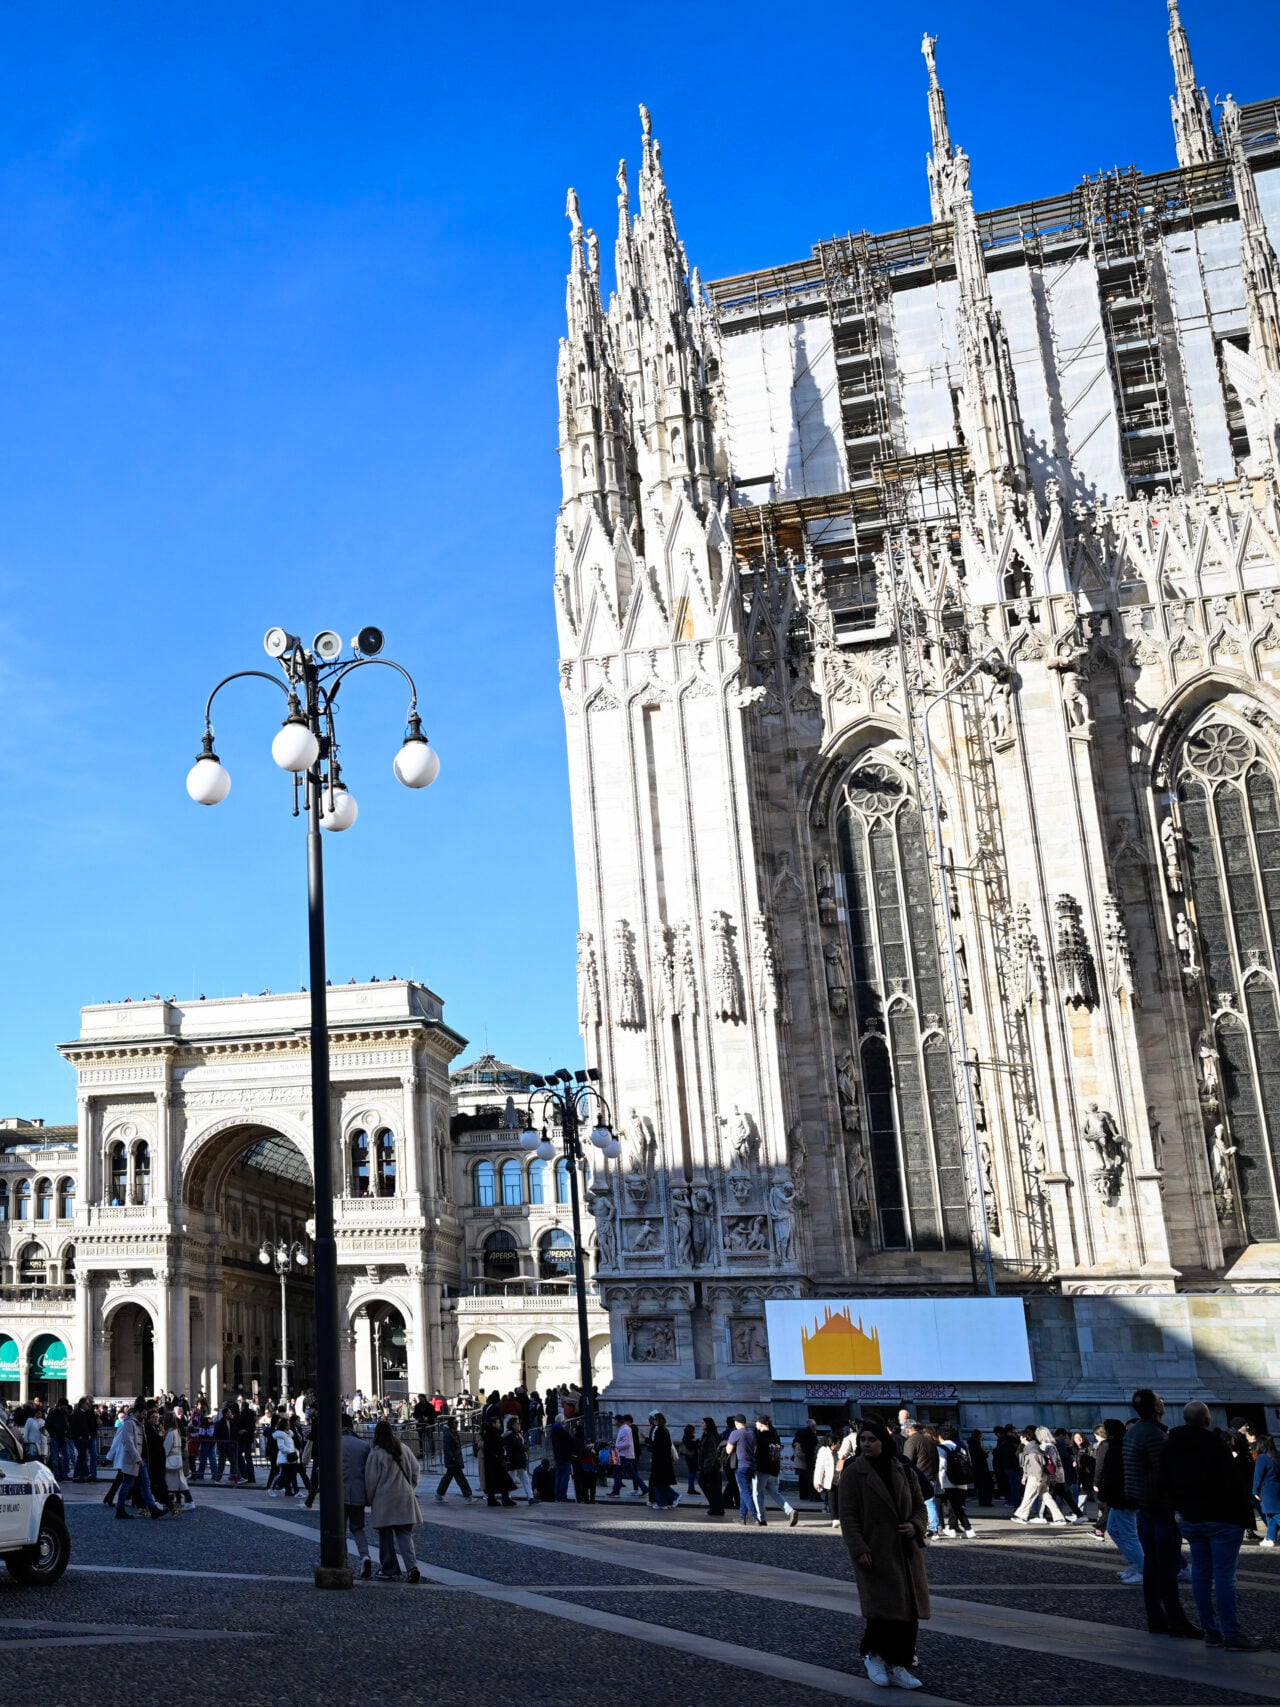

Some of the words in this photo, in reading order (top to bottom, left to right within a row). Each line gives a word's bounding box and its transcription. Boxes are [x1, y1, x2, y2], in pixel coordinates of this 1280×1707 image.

[490, 1251, 516, 1259] APEROL
[545, 1250, 573, 1258] APEROL
[805, 1383, 848, 1391] DUOMO
[858, 1383, 891, 1391] GRUPPI
[896, 1383, 902, 1398] 1
[947, 1383, 958, 1398] 2
[859, 1390, 891, 1398] GROUPS
[914, 1390, 946, 1398] GROUPS
[9, 1485, 25, 1494] CIVILE
[3, 1504, 7, 1512] DI
[7, 1504, 20, 1513] MILANO
